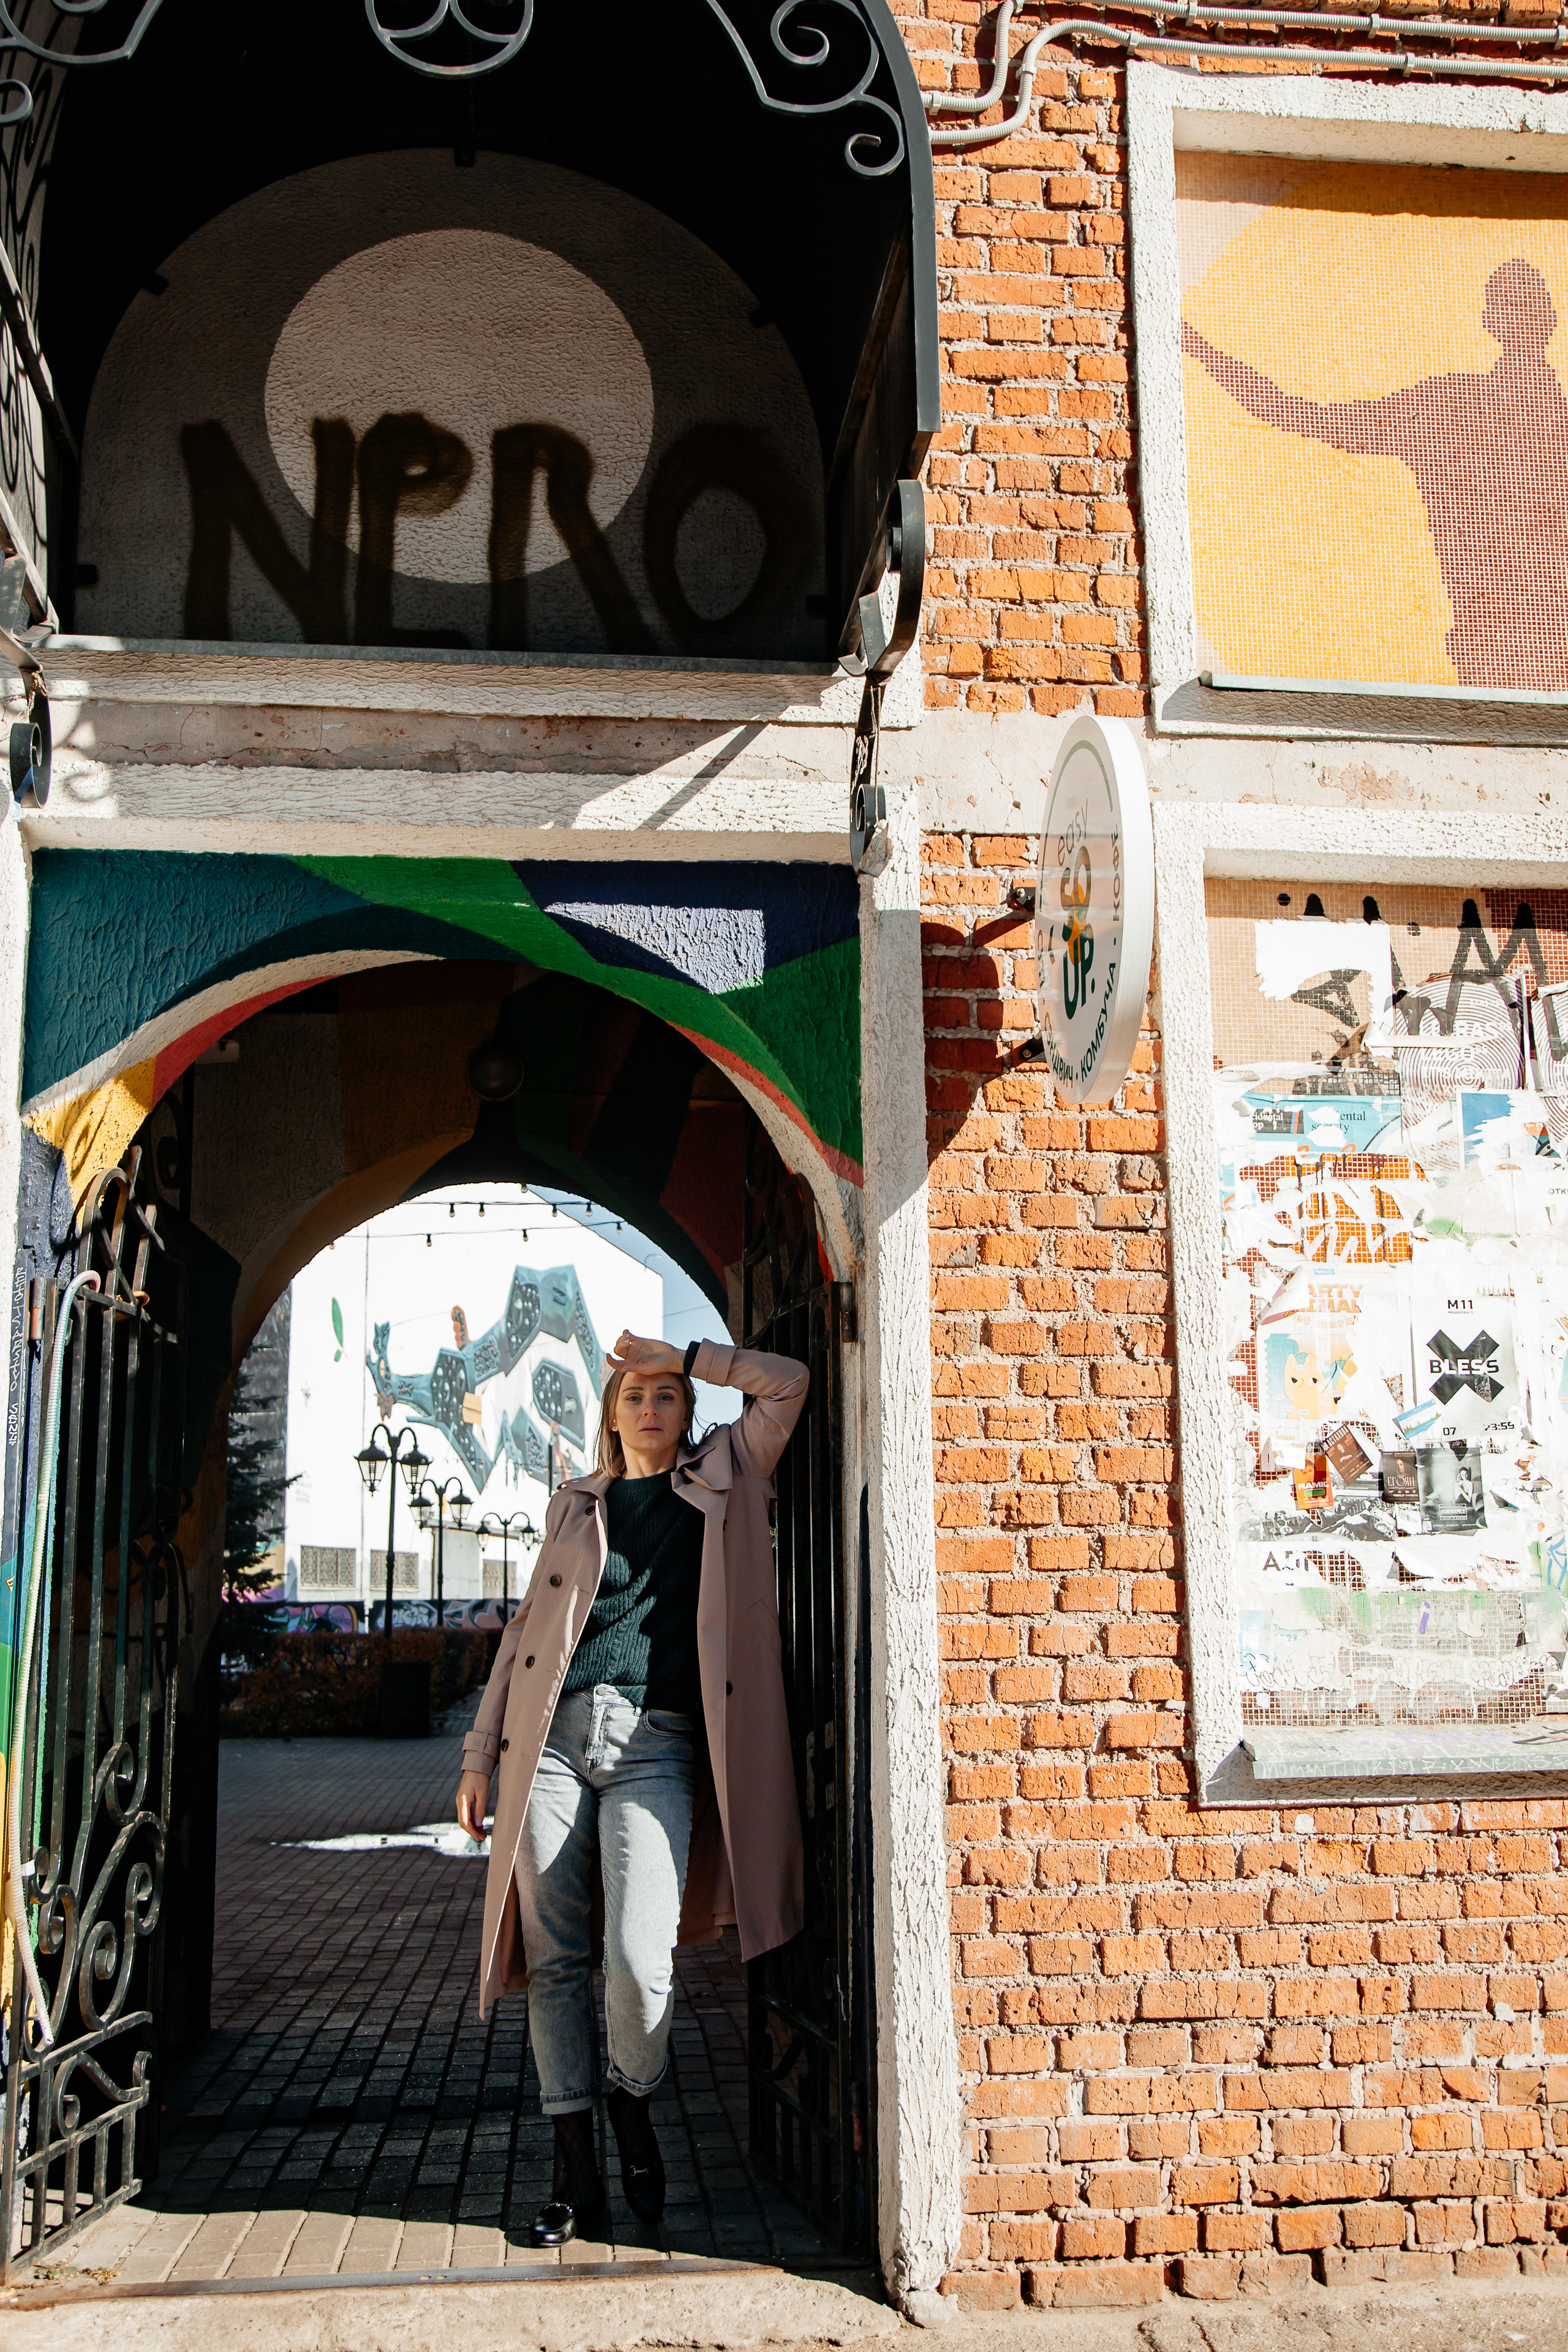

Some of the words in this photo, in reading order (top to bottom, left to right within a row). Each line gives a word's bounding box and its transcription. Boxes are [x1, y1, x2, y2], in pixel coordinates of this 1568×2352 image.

[1057, 798, 1088, 867] easy
[1080, 962, 1117, 1082] КОМБУЧА
[1111, 823, 1120, 921] КОФЕ
[1340, 1110, 1366, 1121] ental
[1308, 1284, 1364, 1298] ARTY
[1447, 1299, 1473, 1310] M11
[1316, 1315, 1359, 1329] markt
[1430, 1358, 1499, 1375] BLESS
[1442, 1427, 1457, 1436] 07
[1387, 1476, 1415, 1487] ЕГОЯН
